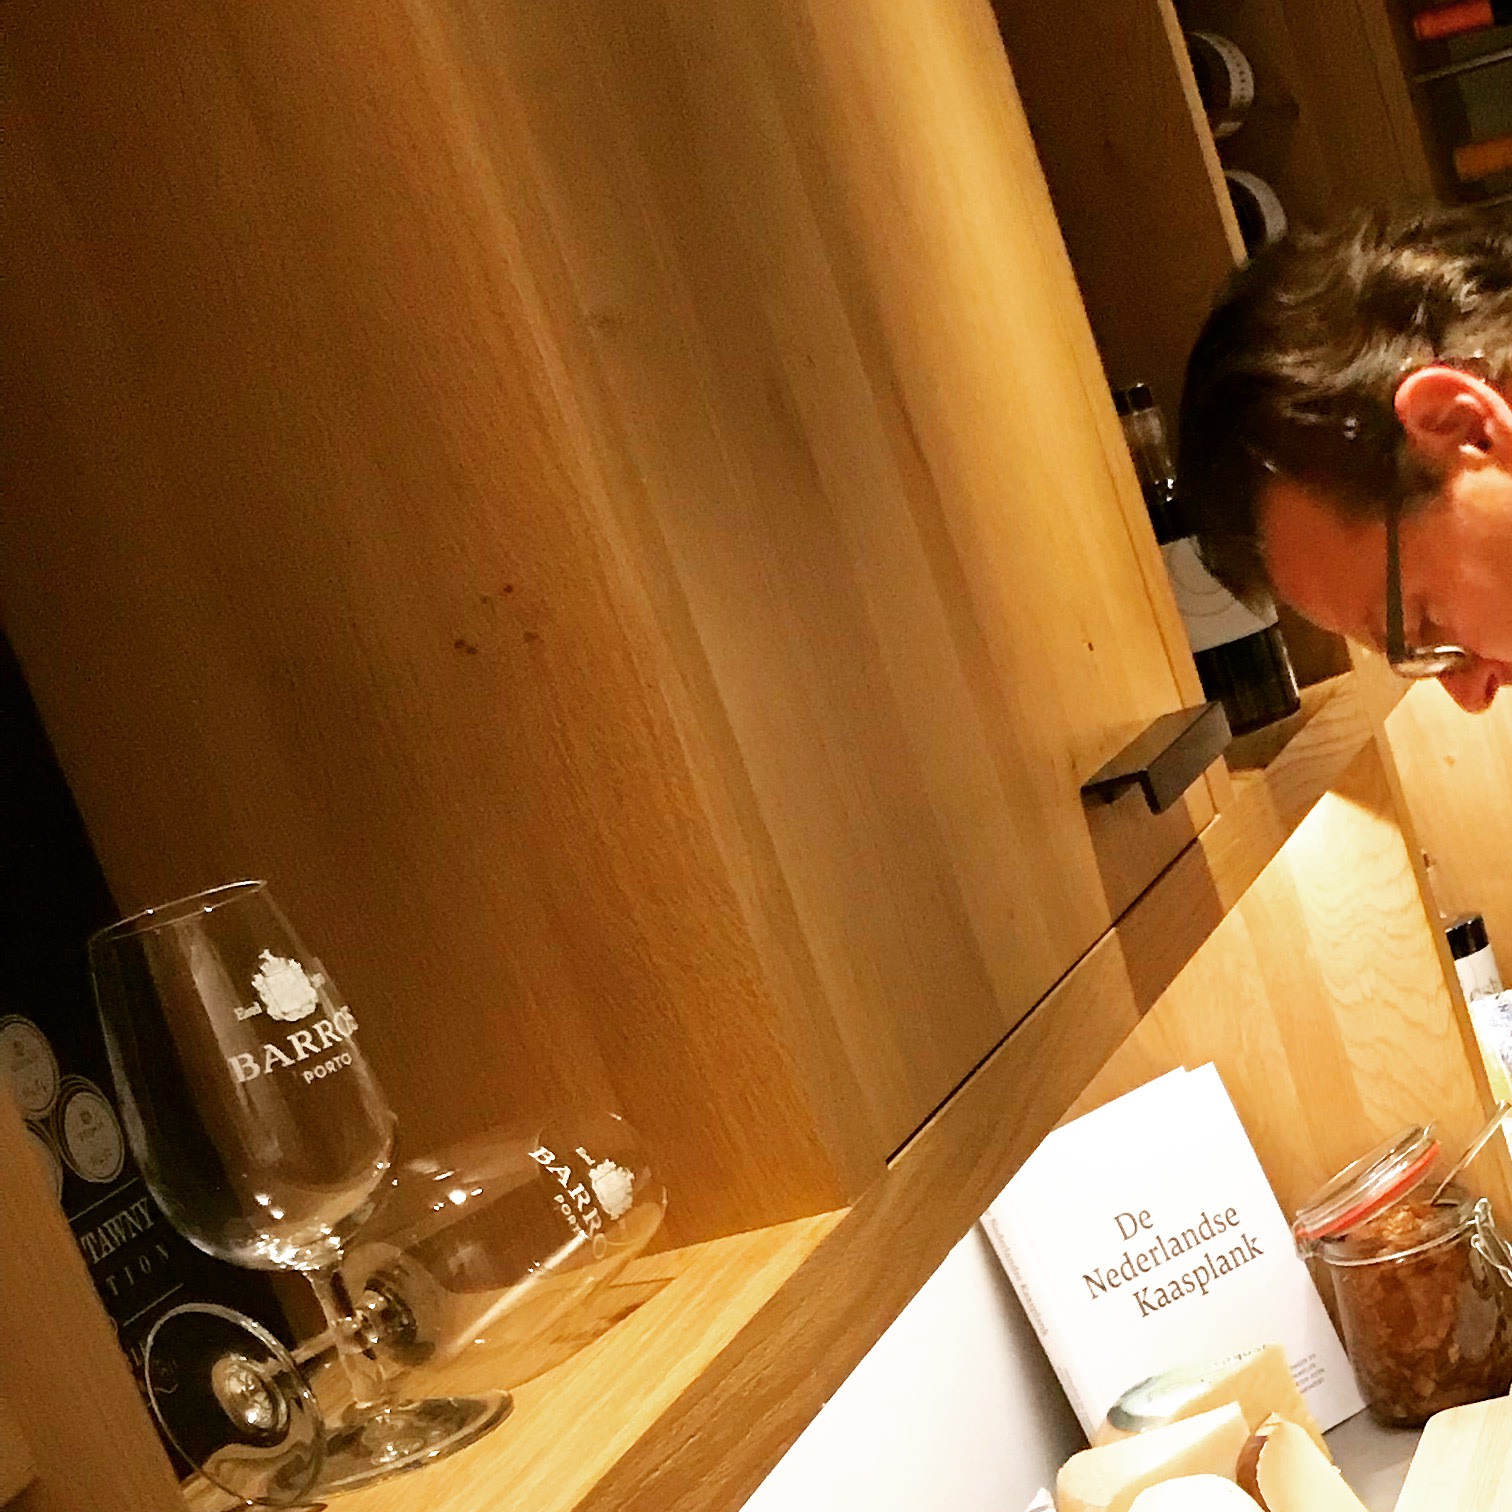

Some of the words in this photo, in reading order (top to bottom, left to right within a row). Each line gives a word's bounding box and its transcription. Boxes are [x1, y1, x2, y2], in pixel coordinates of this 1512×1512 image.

[302, 1052, 353, 1085] PORTO
[80, 1197, 157, 1265] TAWNY
[1082, 1205, 1241, 1300] Nederlandse
[1113, 1208, 1154, 1242] De
[1132, 1233, 1266, 1318] Kaasplank
